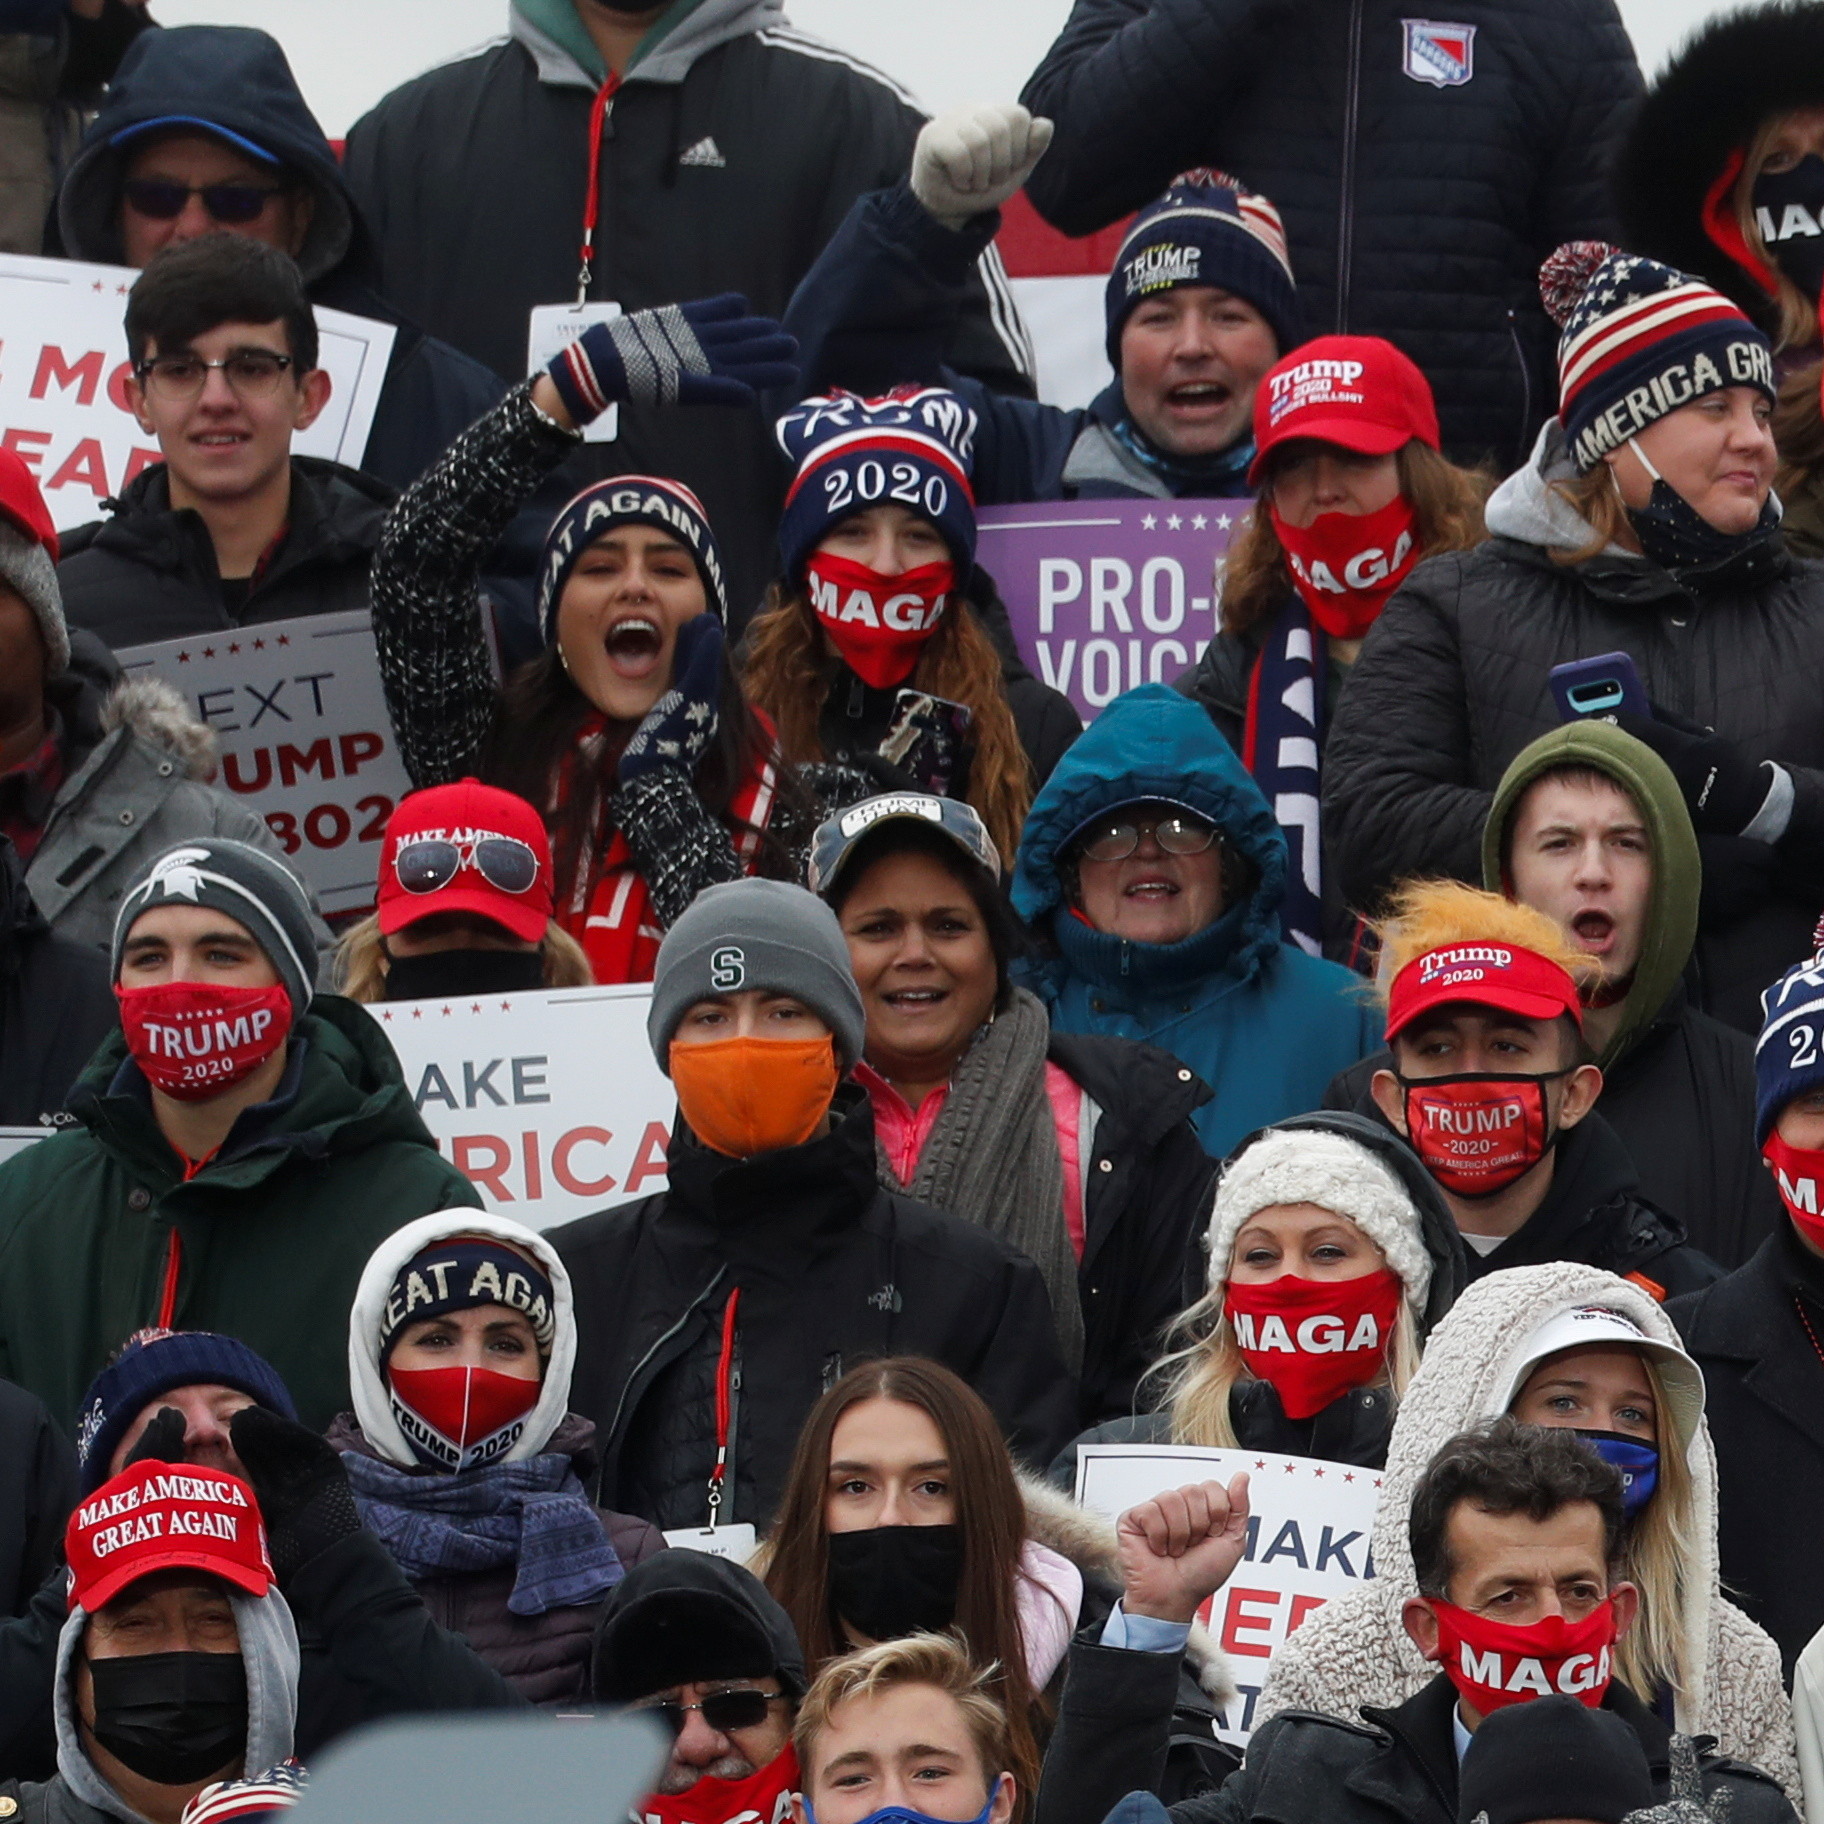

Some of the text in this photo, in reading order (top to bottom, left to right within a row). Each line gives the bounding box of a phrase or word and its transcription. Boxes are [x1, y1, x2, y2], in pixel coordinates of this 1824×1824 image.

[1270, 361, 1363, 397] Trump
[825, 462, 947, 517] 2020
[711, 946, 744, 991] S
[1420, 945, 1512, 972] Trump
[1442, 967, 1485, 985] 2020
[142, 1007, 273, 1061] TRUMP
[183, 1055, 234, 1081] 2020
[1423, 1101, 1521, 1136] TRUMP
[1234, 1311, 1377, 1354] MAGA
[397, 1402, 459, 1466] TRUMP
[470, 1423, 524, 1466] 2020
[78, 1475, 247, 1530] MAKE AMERICA
[93, 1510, 238, 1558] GREAT AGAIN
